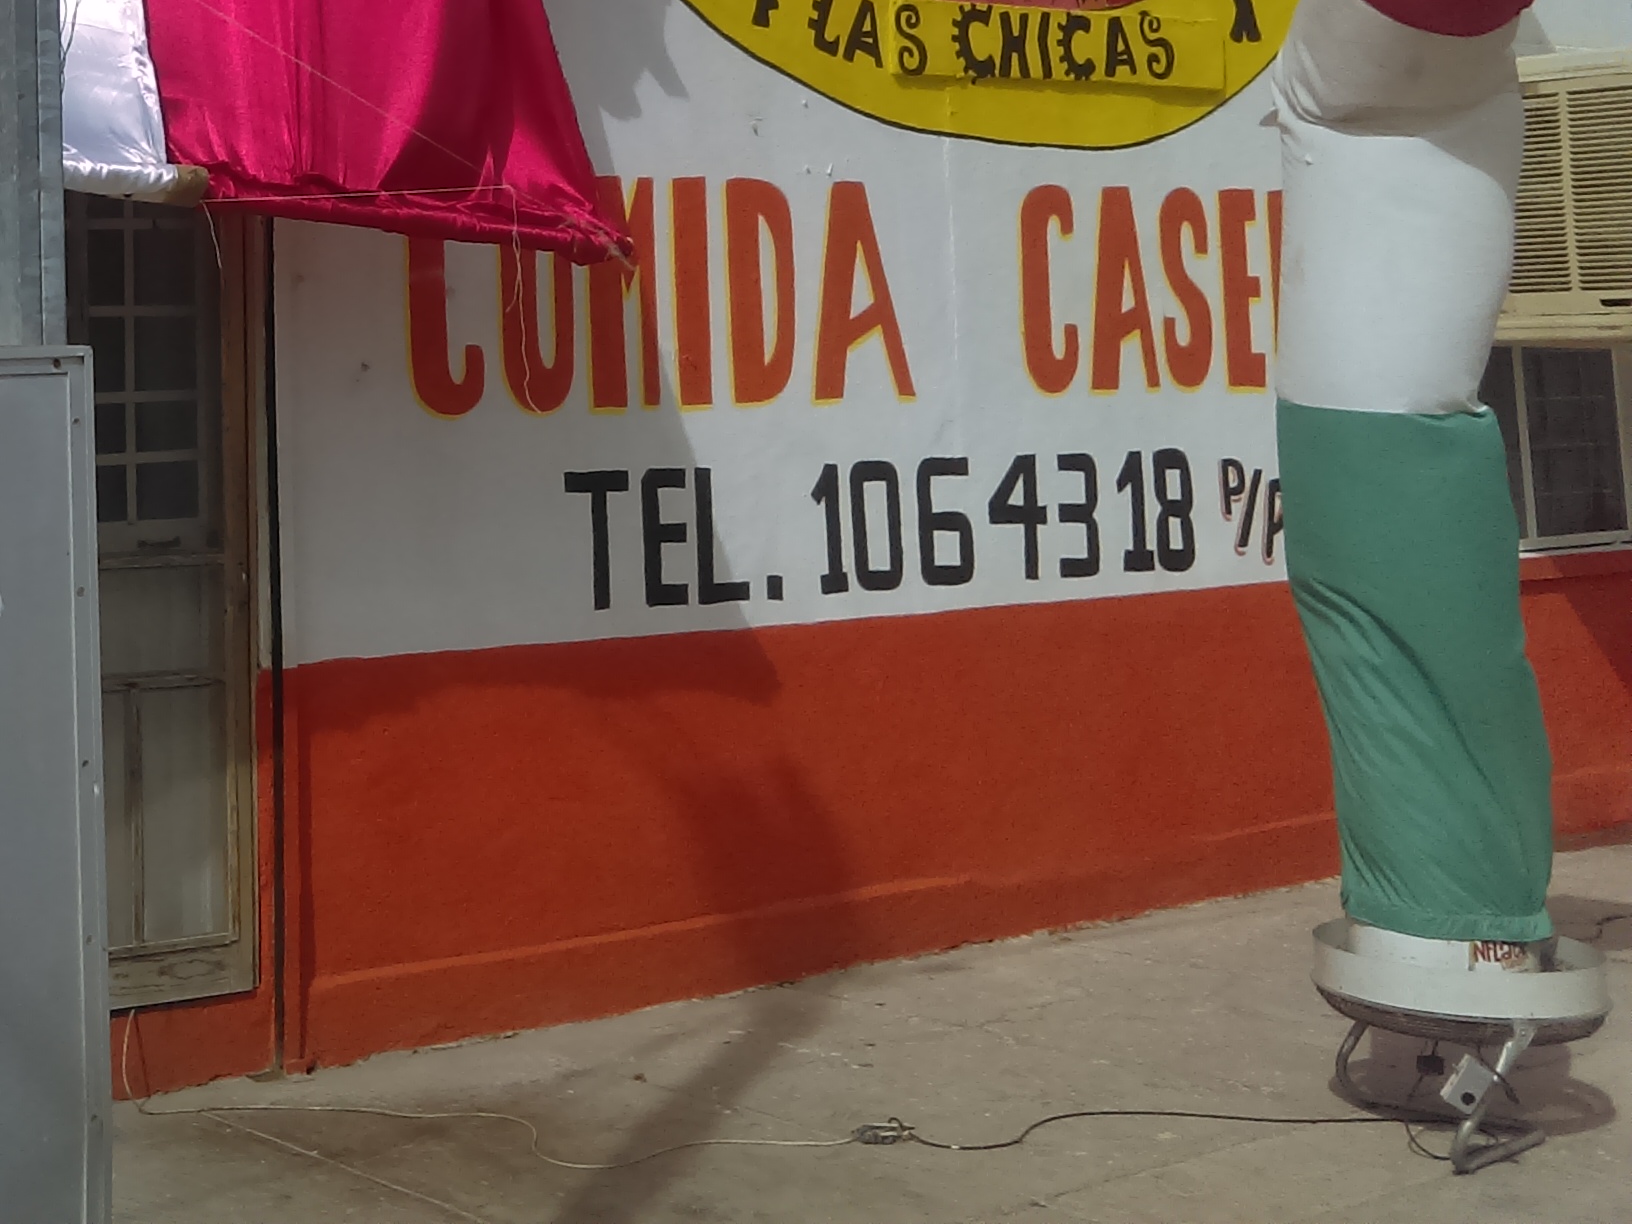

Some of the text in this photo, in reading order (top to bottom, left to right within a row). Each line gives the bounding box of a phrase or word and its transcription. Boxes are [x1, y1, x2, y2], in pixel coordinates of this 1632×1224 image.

[953, 2, 1176, 84] CHICAS
[406, 175, 1282, 420] COMIDA CASE
[564, 466, 783, 610] TEL.
